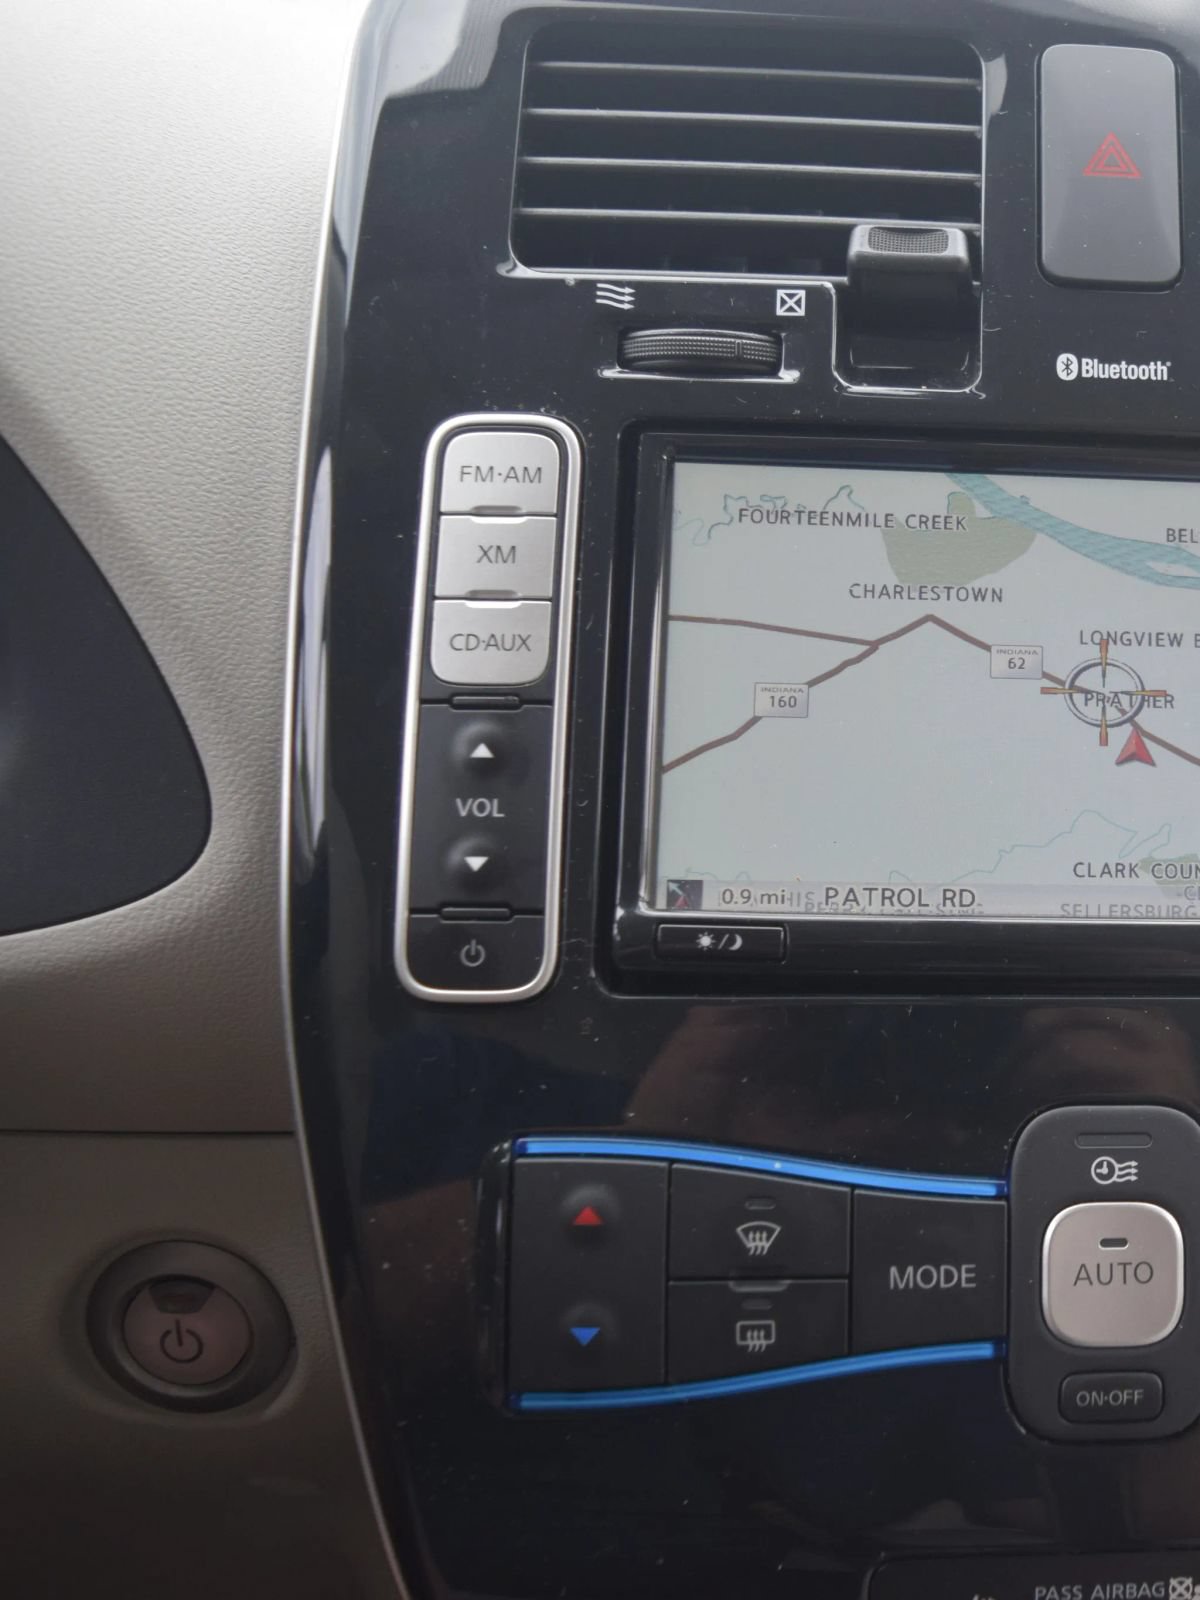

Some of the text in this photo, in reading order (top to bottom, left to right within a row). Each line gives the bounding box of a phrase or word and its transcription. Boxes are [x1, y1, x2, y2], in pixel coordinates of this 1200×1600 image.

[1081, 358, 1168, 381] Bluetooth
[738, 508, 967, 531] FOURTEENMILE CREEK
[477, 545, 517, 564] XM
[849, 583, 1003, 603] CHARLESTOWN
[1080, 630, 1183, 648] LONGVIEW
[1007, 657, 1026, 670] 62
[770, 695, 797, 708] 160
[456, 797, 505, 818] VOL
[1073, 862, 1140, 879] CLARK
[722, 888, 751, 904] 0.9
[760, 889, 785, 904] mi
[825, 887, 929, 907] PATROL
[942, 888, 976, 907] RD
[889, 1264, 977, 1289] MODE
[1074, 1262, 1154, 1286] AUTO
[1035, 1582, 1166, 1600] PASS AIRBAG
